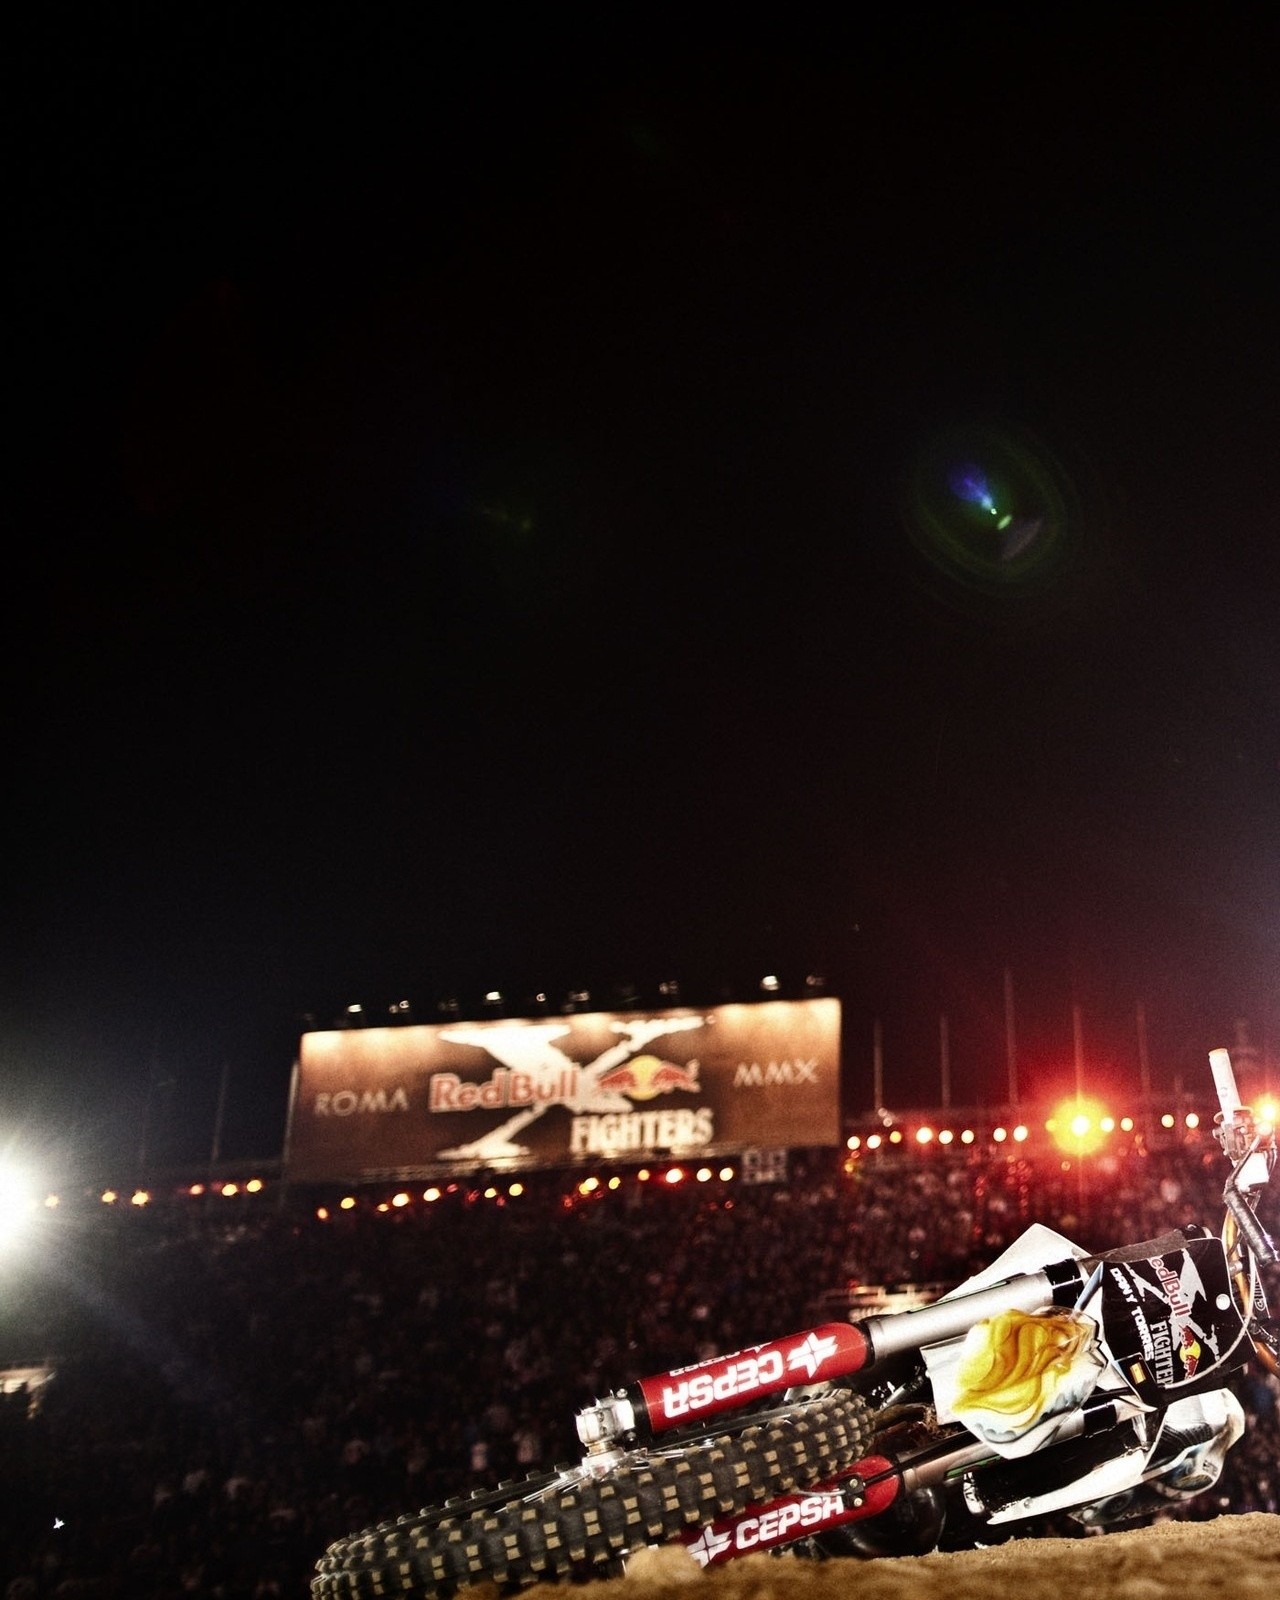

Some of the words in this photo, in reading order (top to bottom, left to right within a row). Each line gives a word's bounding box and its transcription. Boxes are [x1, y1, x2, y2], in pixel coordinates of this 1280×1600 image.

[430, 1068, 507, 1112] Red
[509, 1064, 582, 1107] Bull
[733, 1057, 819, 1087] MMX
[314, 1087, 410, 1117] ROMA
[569, 1108, 714, 1156] FIGHTERS
[1148, 1254, 1178, 1283] ed
[1109, 1267, 1138, 1303] DANY
[1131, 1305, 1155, 1361] TORRES
[1162, 1277, 1193, 1318] Bull
[1150, 1319, 1175, 1386] FIGHTER
[662, 1349, 784, 1419] CEPSA
[735, 1488, 845, 1550] CEPSA
